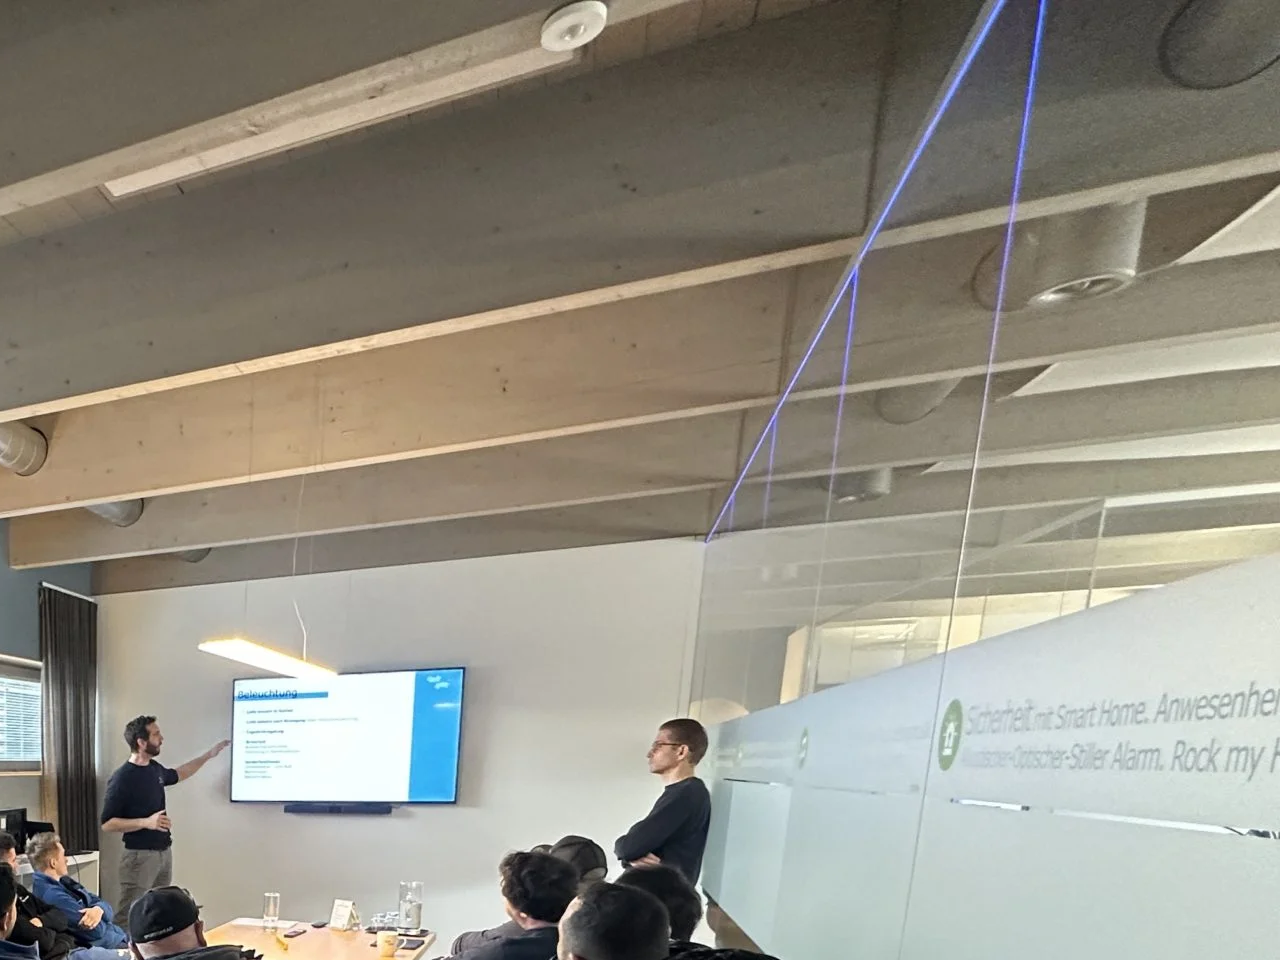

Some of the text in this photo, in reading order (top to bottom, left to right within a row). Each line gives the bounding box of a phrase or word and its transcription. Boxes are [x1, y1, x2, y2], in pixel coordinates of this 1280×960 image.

[237, 689, 298, 699] Beleuchtung
[1055, 702, 1098, 730] Smart
[1099, 697, 1149, 727] Home.
[1110, 740, 1164, 772] Alarm.
[1170, 738, 1222, 773] Rock
[1224, 745, 1267, 782] my
